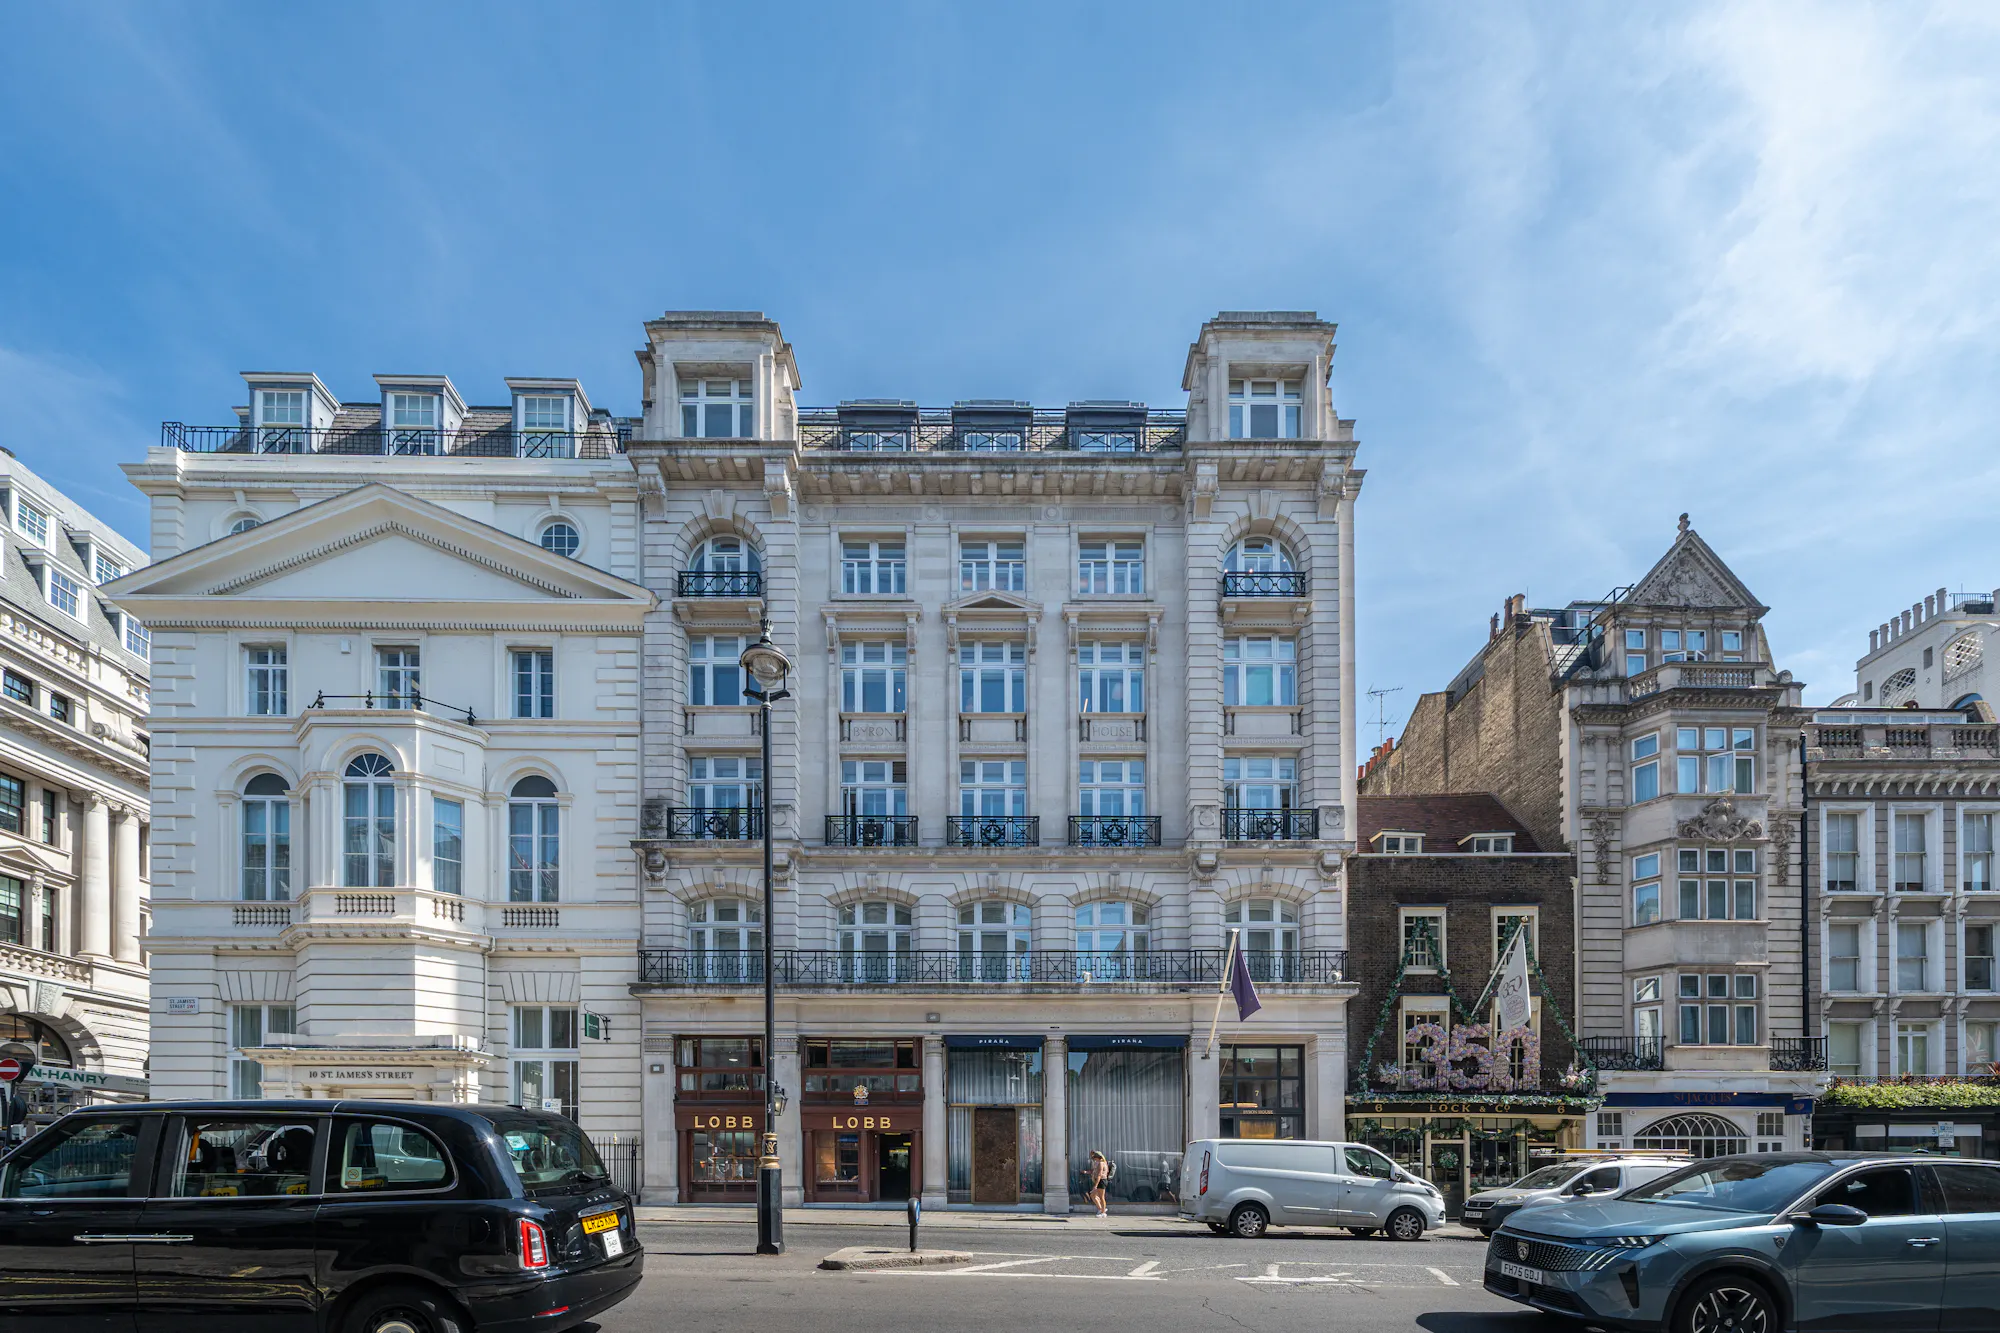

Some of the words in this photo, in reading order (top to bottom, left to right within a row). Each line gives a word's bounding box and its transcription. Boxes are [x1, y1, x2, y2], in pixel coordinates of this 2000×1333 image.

[853, 726, 893, 737] BYRON
[1092, 726, 1133, 737] HOUSE
[1405, 1022, 1541, 1092] 350
[309, 1071, 318, 1079] 10
[335, 1070, 373, 1079] JAMES'S
[375, 1071, 414, 1079] STREET
[1685, 1092, 1732, 1104] JACQUES
[1375, 1104, 1383, 1112] 6
[1429, 1104, 1471, 1113] LOCK
[1557, 1105, 1565, 1114] 6
[694, 1115, 753, 1129] LOBB
[832, 1116, 891, 1129] LOBB
[1503, 1263, 1523, 1277] FH75
